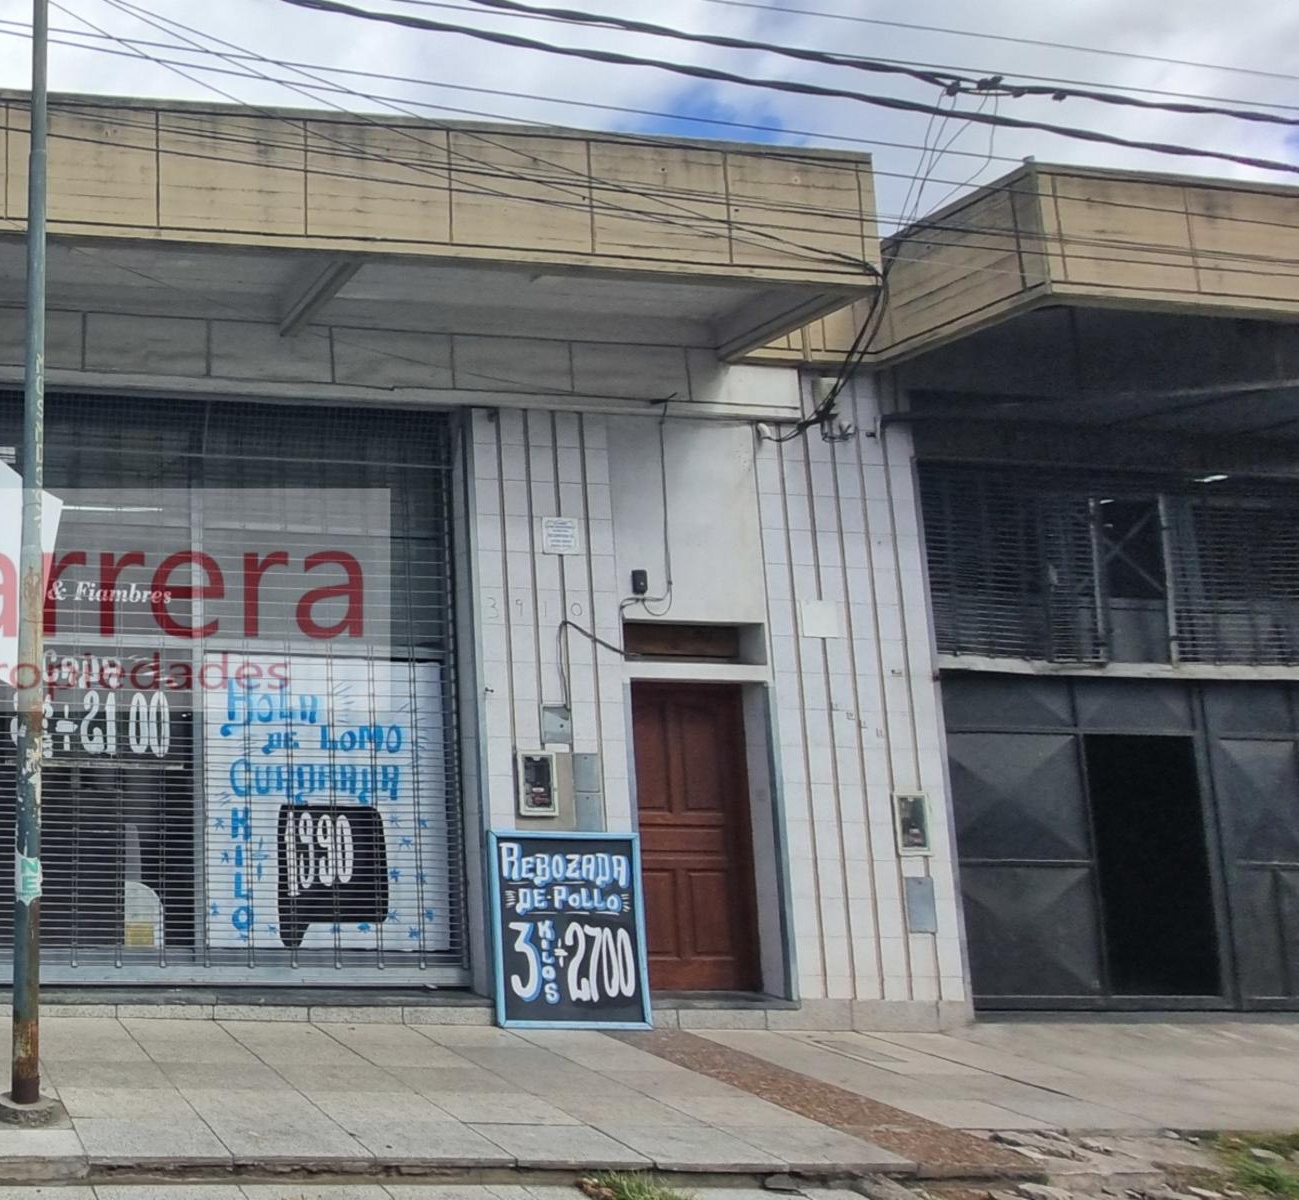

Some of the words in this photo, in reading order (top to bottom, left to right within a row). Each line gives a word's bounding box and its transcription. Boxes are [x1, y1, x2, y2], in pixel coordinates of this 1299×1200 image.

[73, 580, 172, 604] Fiambres
[284, 811, 355, 897] 1990
[499, 841, 631, 889] REBOZADA
[508, 920, 543, 1003] 3
